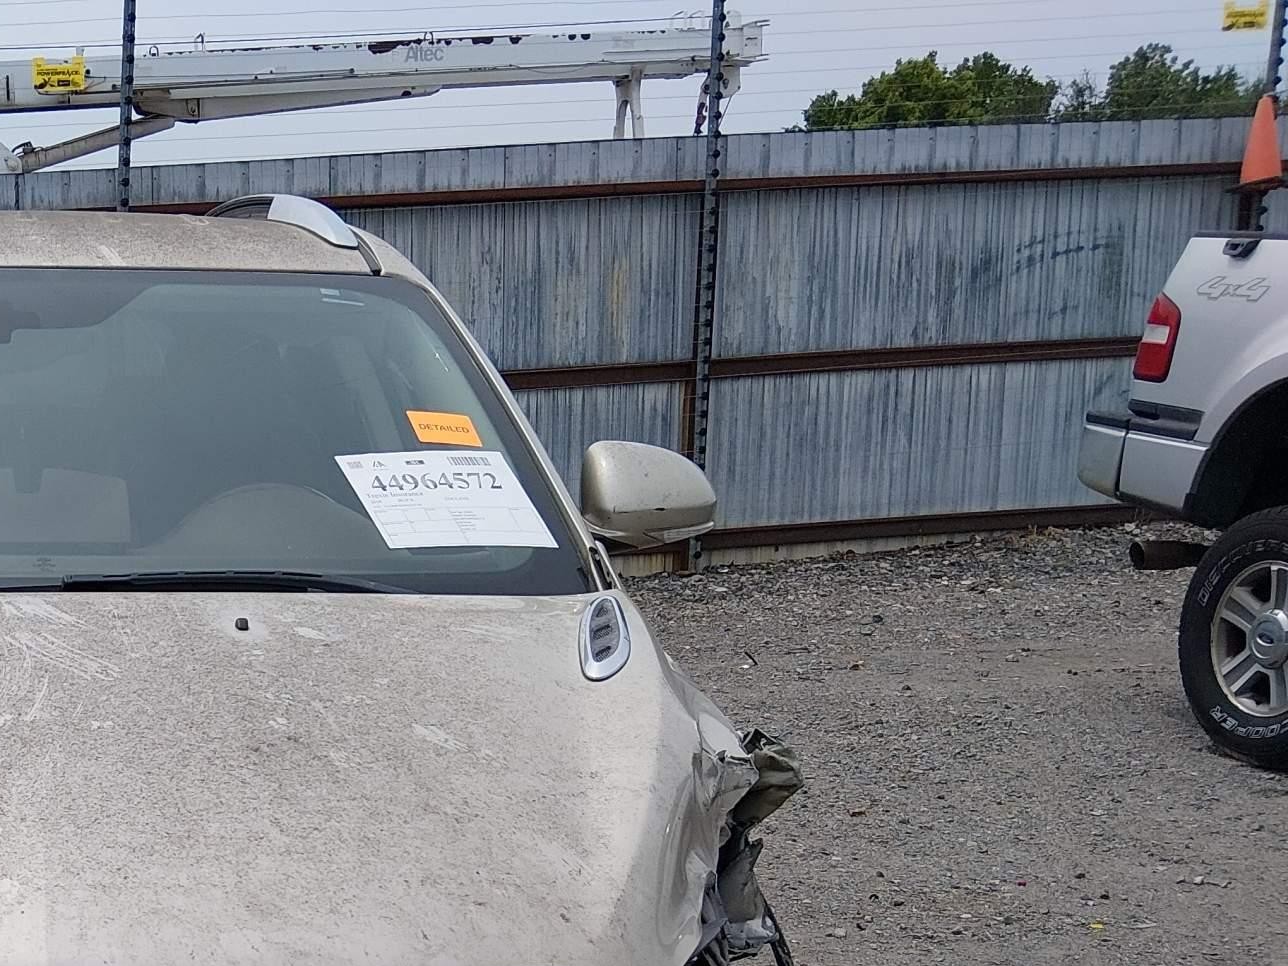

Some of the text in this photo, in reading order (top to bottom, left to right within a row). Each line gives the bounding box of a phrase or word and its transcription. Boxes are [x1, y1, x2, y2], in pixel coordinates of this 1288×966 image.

[404, 45, 445, 62] Altec
[1196, 275, 1272, 302] 4x4
[418, 423, 470, 434] DETAILED
[371, 472, 503, 491] 44964572
